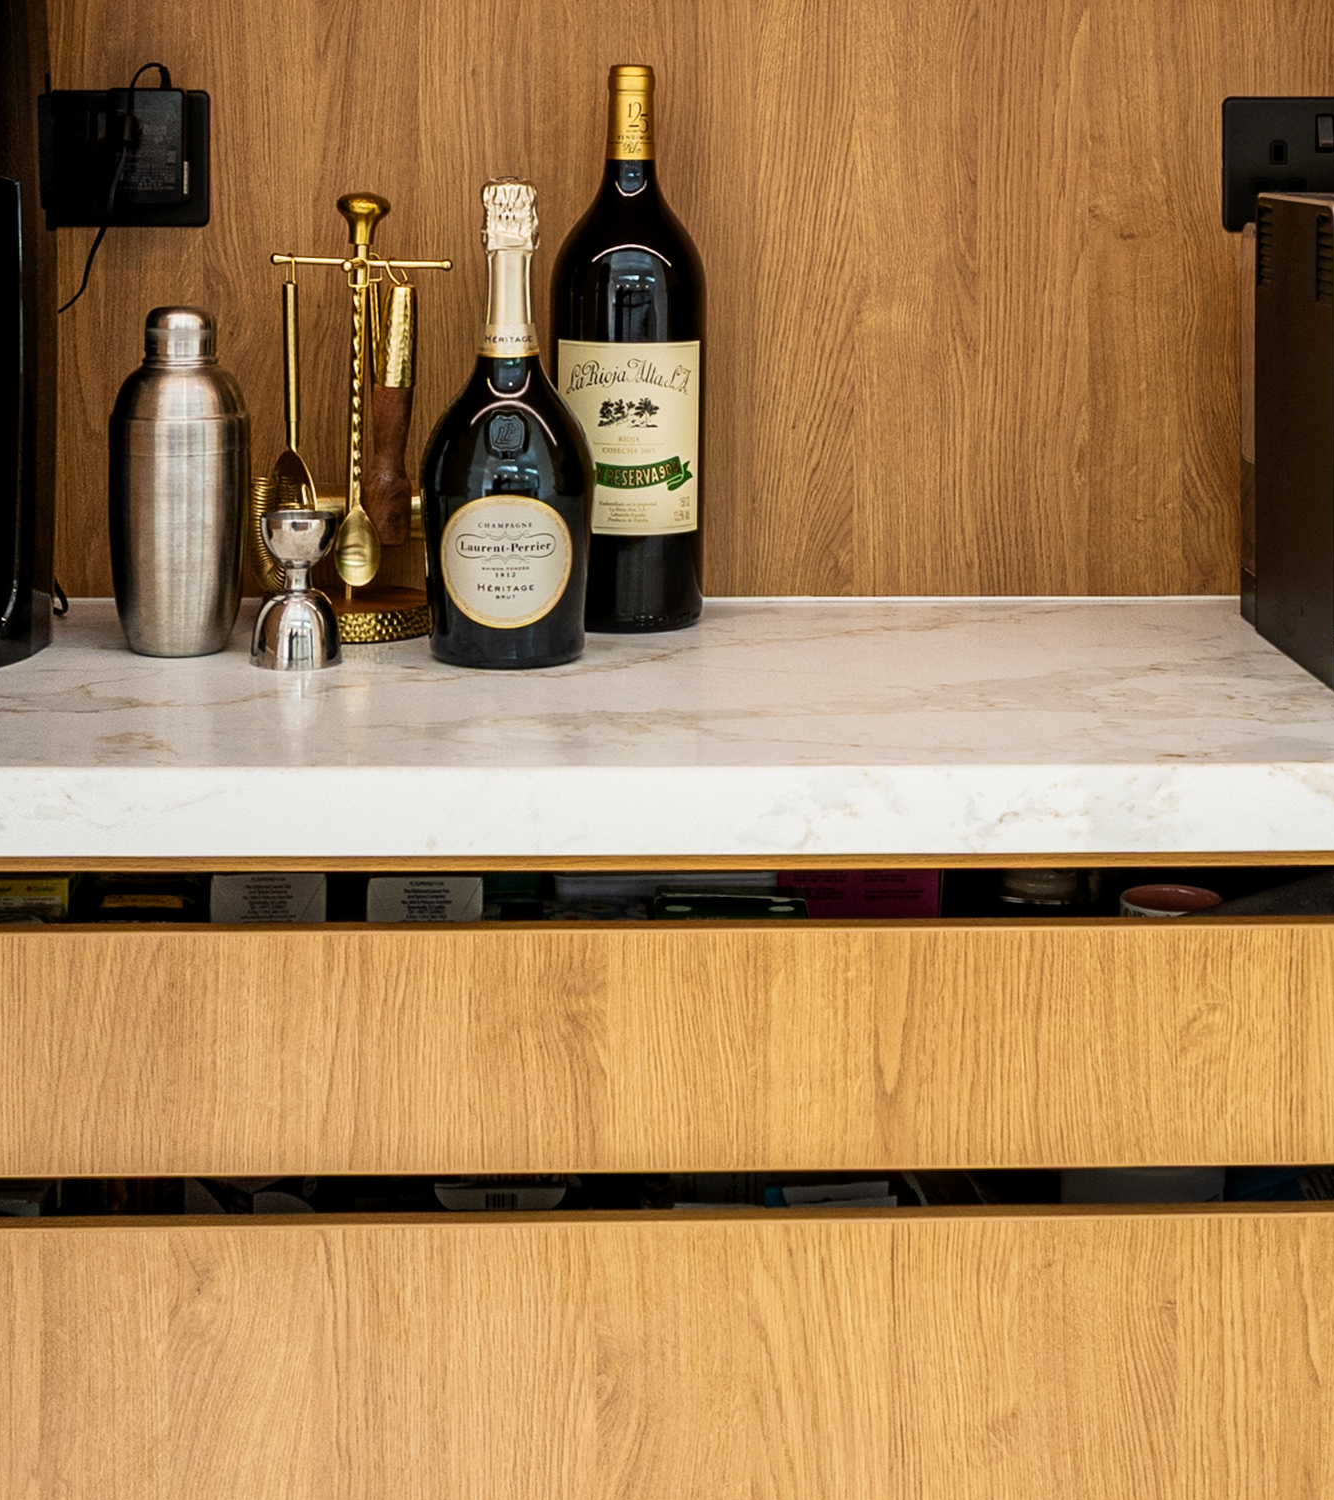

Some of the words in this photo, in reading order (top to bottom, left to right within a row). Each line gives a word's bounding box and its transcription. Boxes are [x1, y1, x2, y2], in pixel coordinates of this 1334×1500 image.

[484, 334, 533, 344] HÉRITAGE
[602, 447, 639, 455] COSECHA
[607, 466, 660, 486] RESERVA
[477, 521, 533, 529] CHAMPAGNE
[460, 540, 552, 553] Laurent-Perrier
[477, 582, 535, 592] HÉRITAGE
